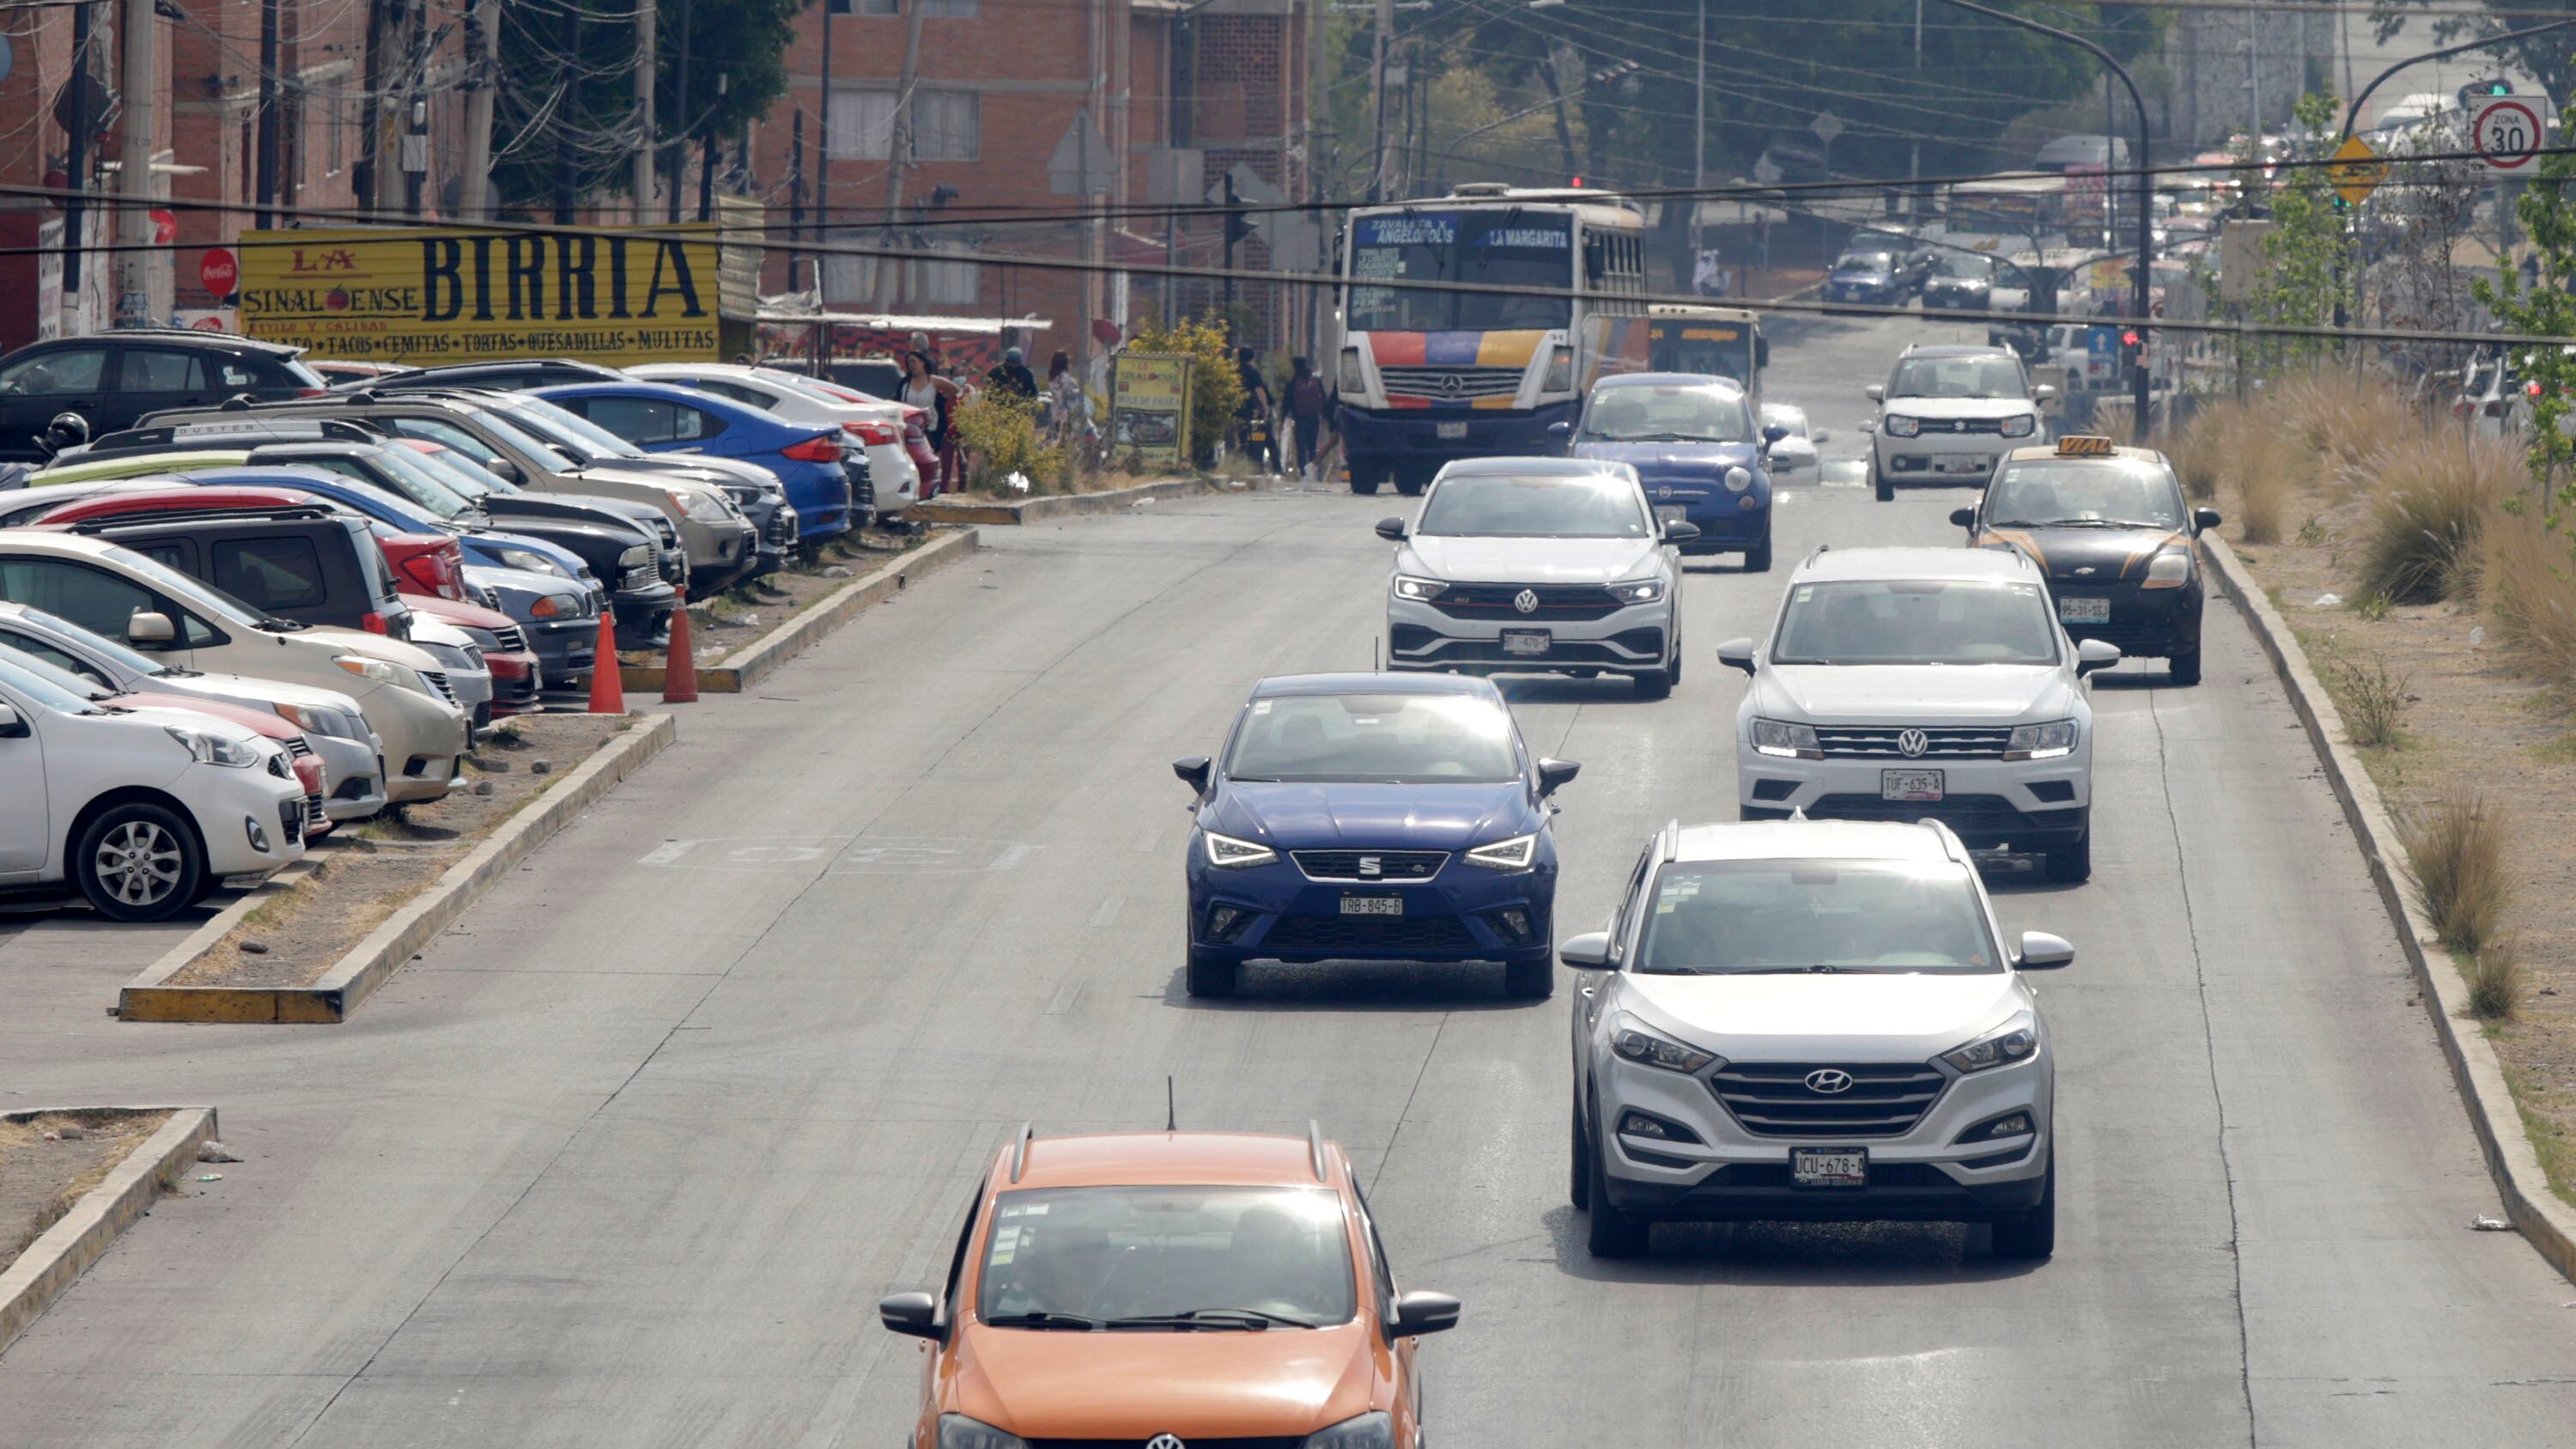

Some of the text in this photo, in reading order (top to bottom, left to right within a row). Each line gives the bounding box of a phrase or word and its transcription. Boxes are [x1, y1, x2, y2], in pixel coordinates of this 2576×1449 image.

[2494, 115, 2520, 125] ZONA
[2491, 126, 2524, 155] 30
[1490, 229, 1568, 248] LA MARGARITA
[292, 249, 357, 271] LA
[421, 234, 708, 322] BIRRIA
[325, 321, 388, 333] CALIDAD
[327, 336, 373, 354] TACOS
[384, 334, 450, 353] CEMITAS
[462, 333, 517, 352] TORTAS
[528, 331, 626, 351] QUESADILLAS
[638, 330, 714, 350] MULITAS
[179, 424, 254, 435] DUSTER
[1886, 777, 1940, 791] TUF-635-A
[1340, 898, 1401, 915] TRB-845-B
[1795, 1158, 1863, 1175] UCU-678-A
